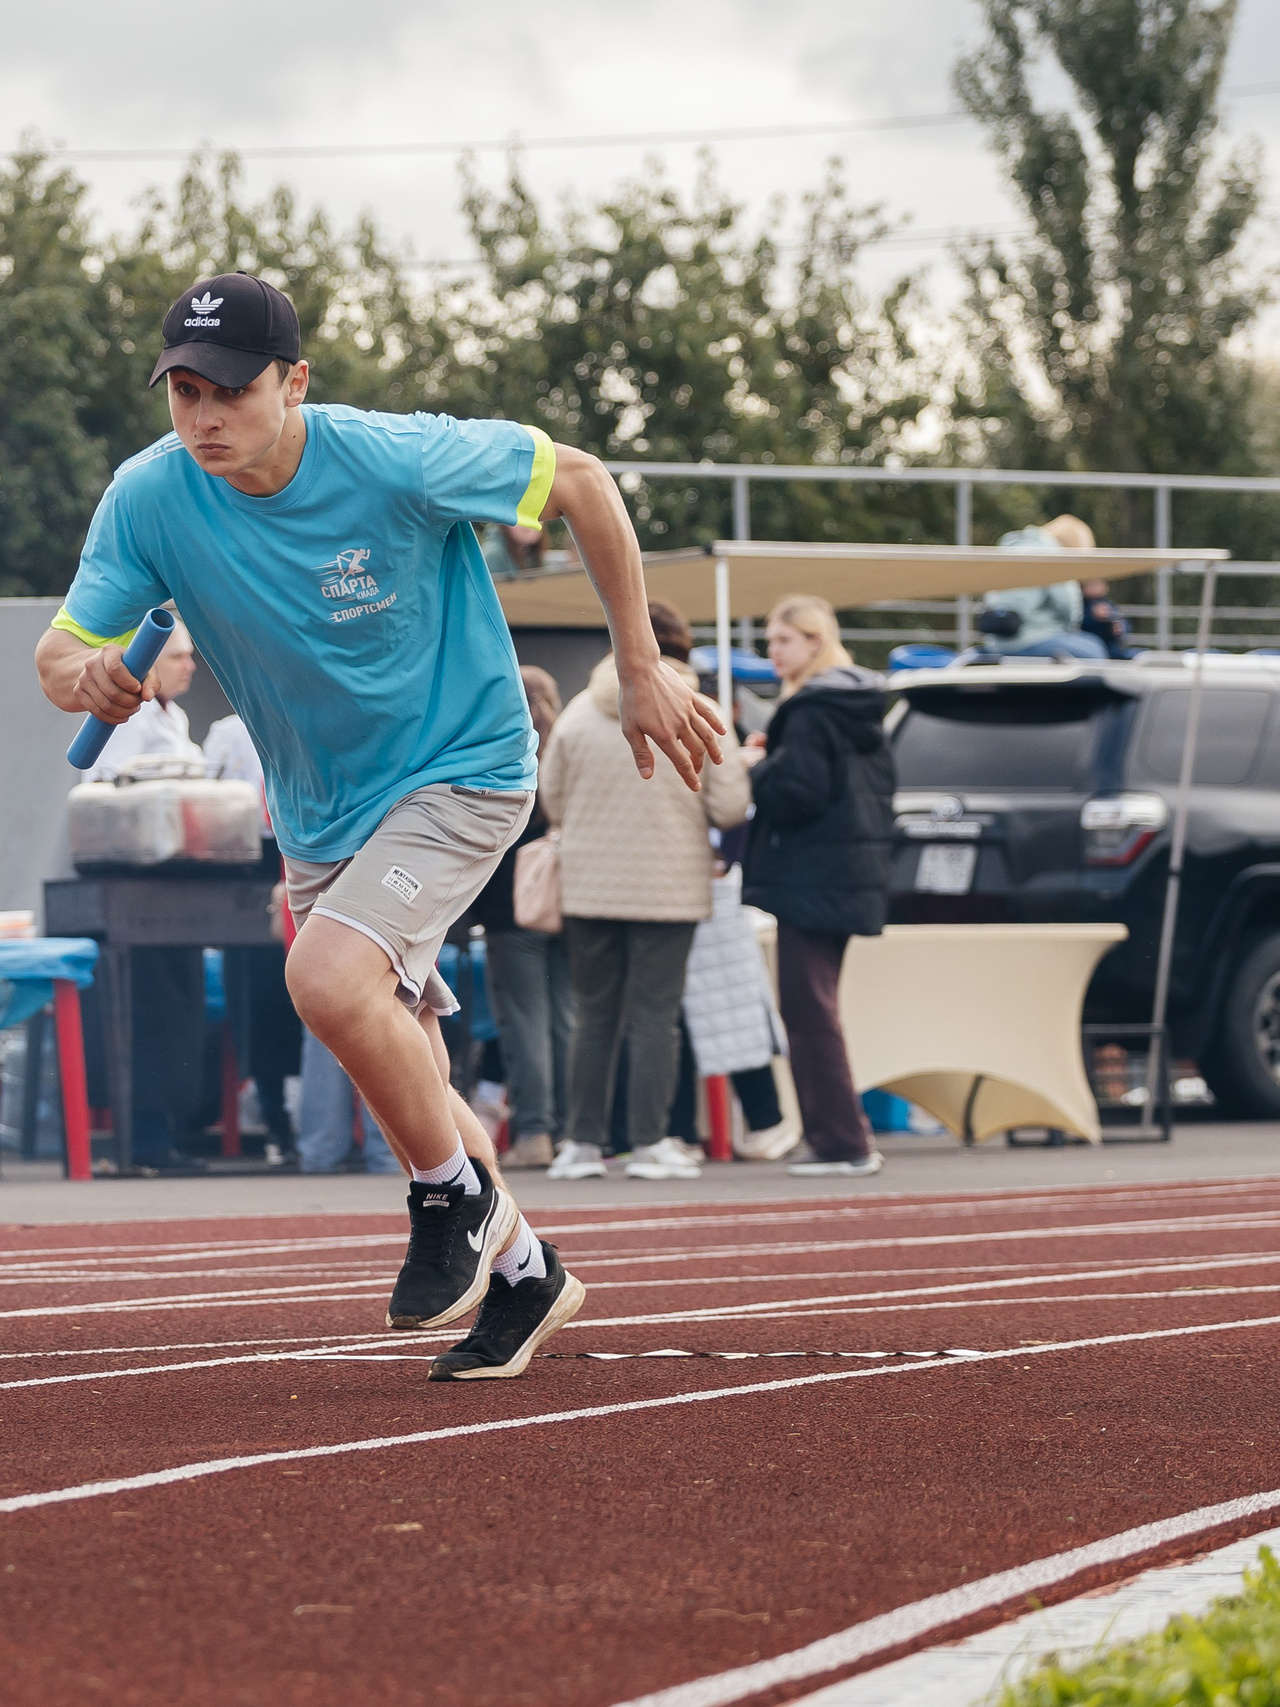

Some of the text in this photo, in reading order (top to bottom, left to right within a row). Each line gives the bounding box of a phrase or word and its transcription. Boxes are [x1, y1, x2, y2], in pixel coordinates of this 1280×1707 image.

[184, 316, 220, 327] adidas
[321, 575, 377, 598] СПАРТА
[355, 586, 380, 600] КИАДА
[331, 591, 397, 623] СПОРТСМЕН
